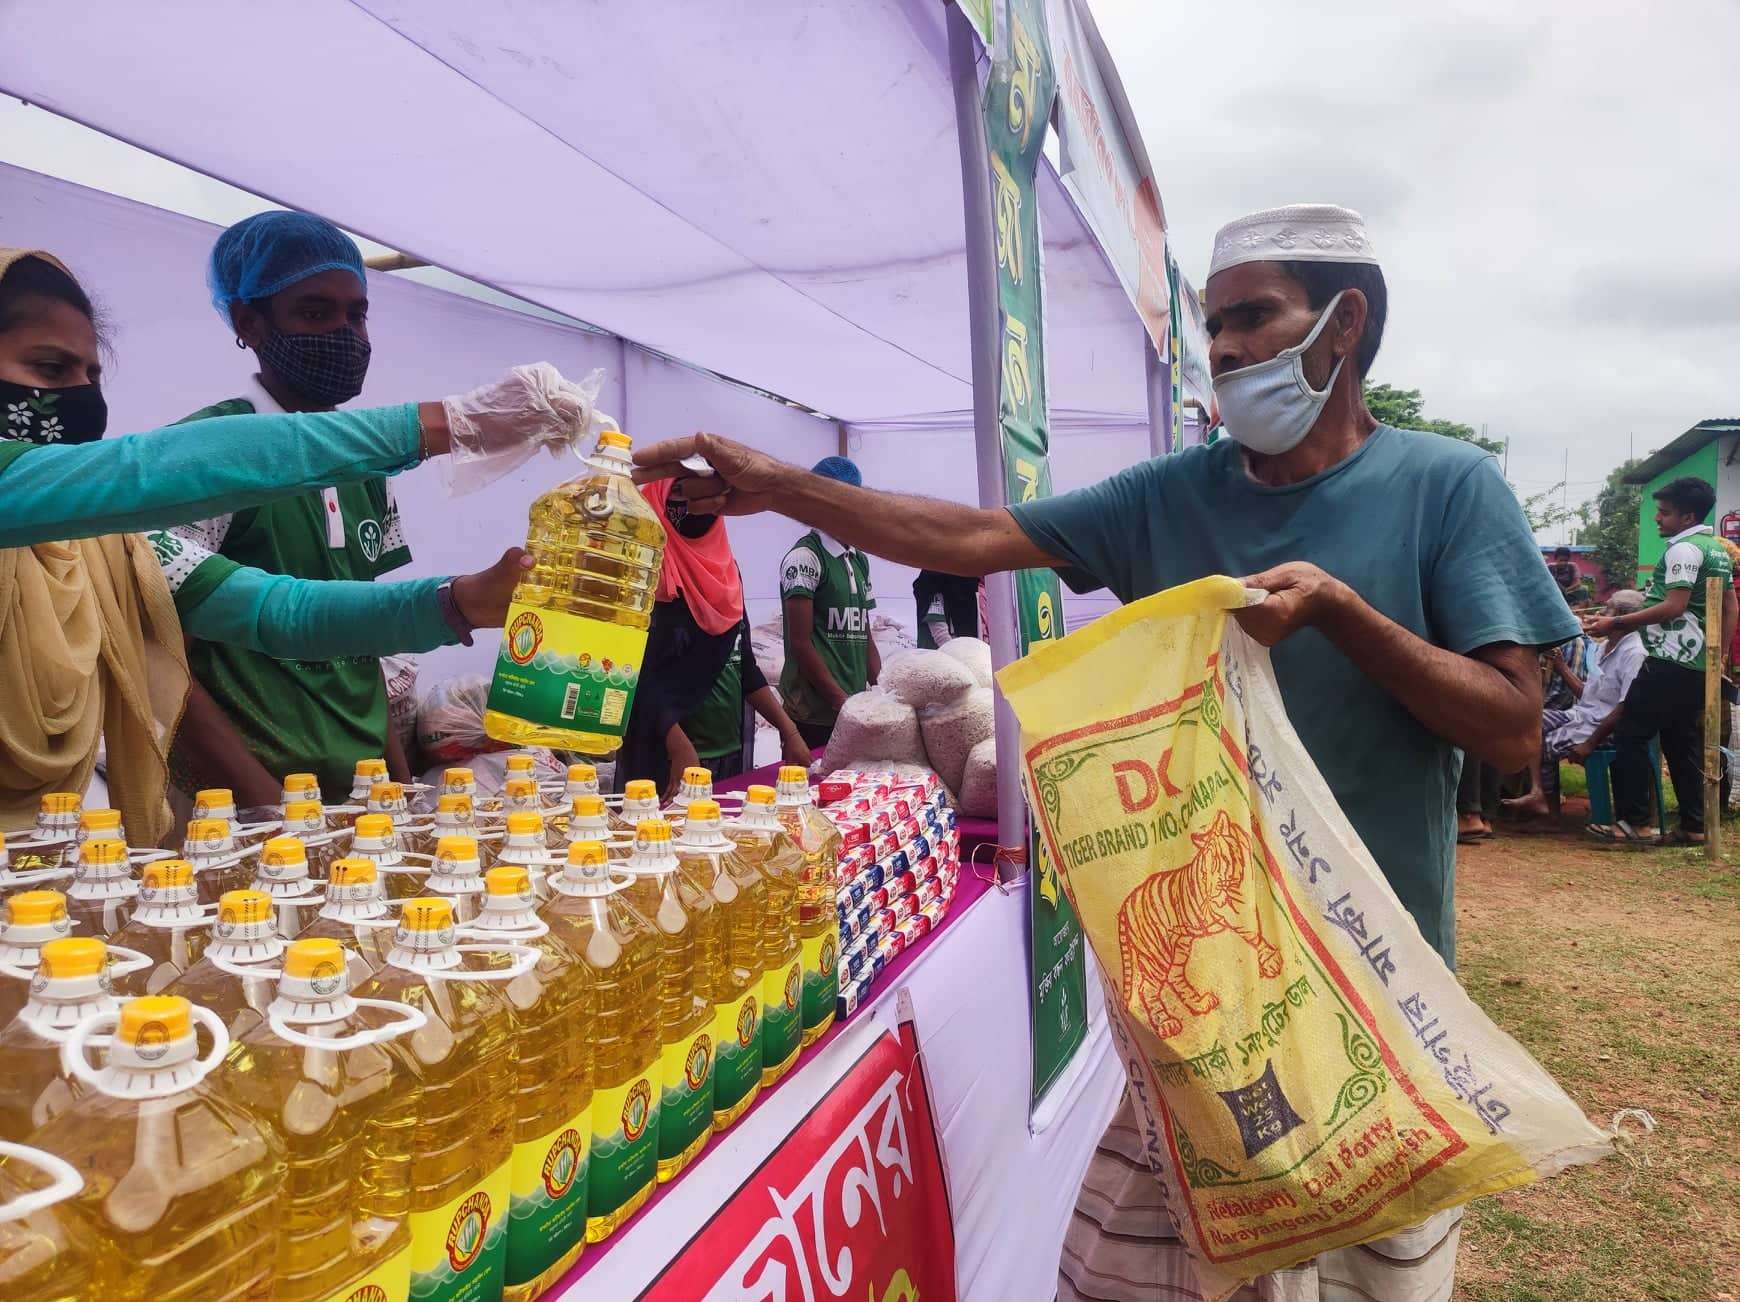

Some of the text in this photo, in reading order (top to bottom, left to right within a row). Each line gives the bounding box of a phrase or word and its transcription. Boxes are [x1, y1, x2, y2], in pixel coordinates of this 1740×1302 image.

[1063, 834, 1098, 870] TIGER
[1097, 821, 1150, 857] BRAND
[1323, 891, 1397, 989] মার্কা
[1398, 991, 1511, 1137] টাইগার
[1254, 1109, 1275, 1127] 25
[1303, 1160, 1344, 1199] Dal
[1208, 1204, 1331, 1247] Narayangonj
